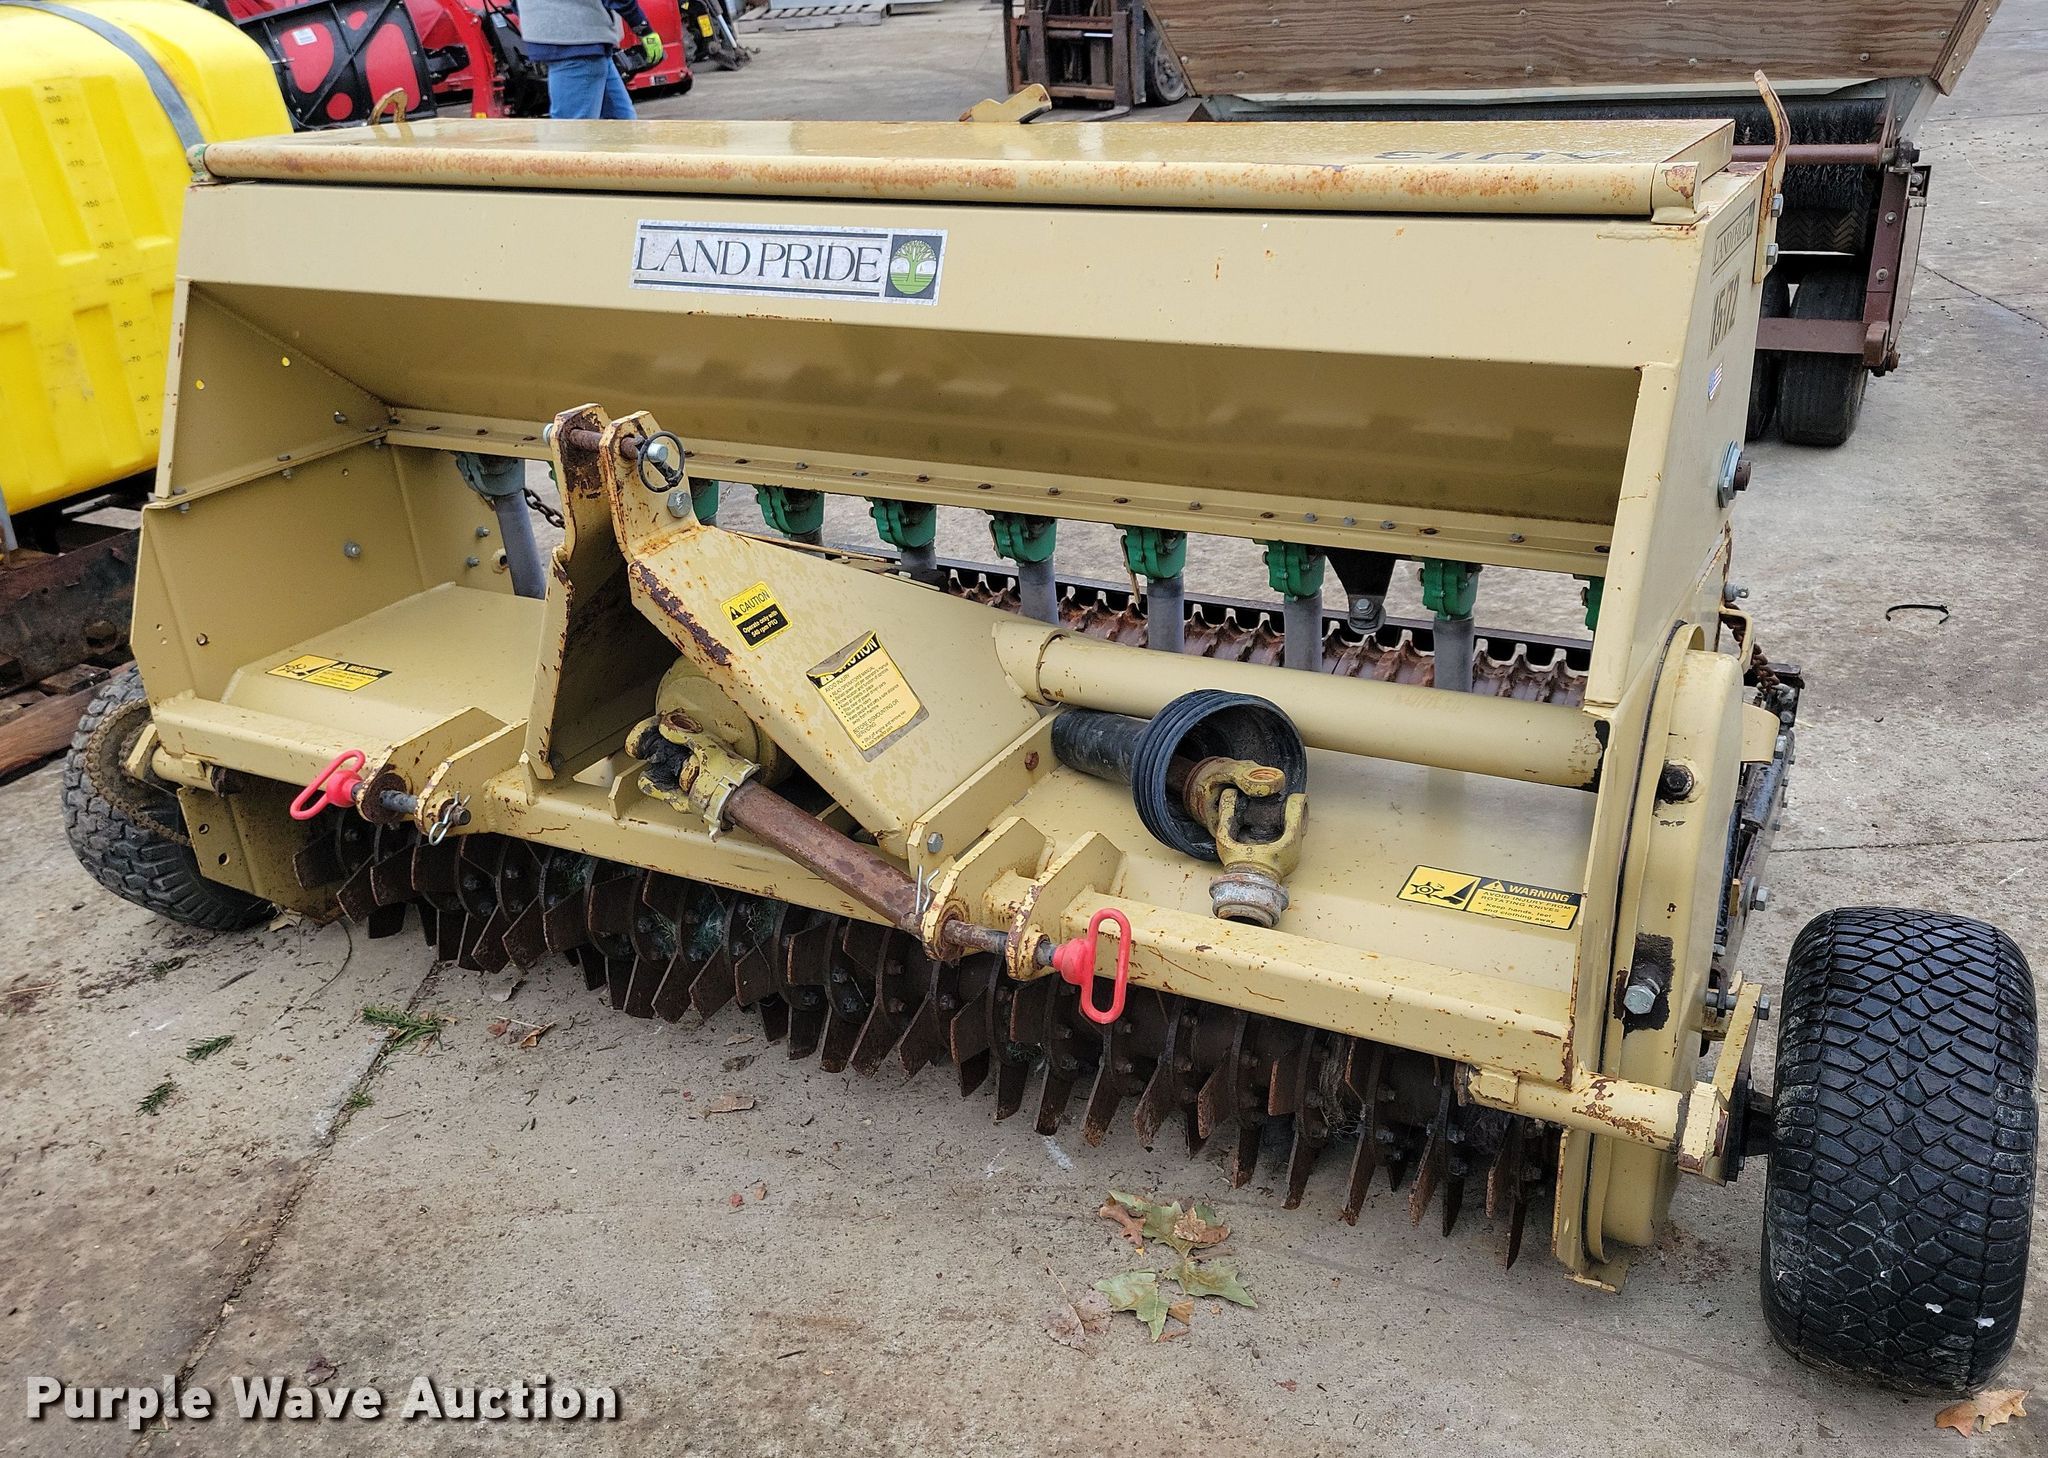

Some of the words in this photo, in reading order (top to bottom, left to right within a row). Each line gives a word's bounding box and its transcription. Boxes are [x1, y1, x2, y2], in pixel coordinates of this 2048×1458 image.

[636, 237, 751, 276] LAND
[758, 242, 883, 283] PRIDE
[739, 590, 770, 612] CAUTION
[743, 621, 760, 633] Operate
[768, 619, 778, 627] PTO
[825, 682, 838, 693] AVOID
[836, 674, 850, 685] INJURY
[1483, 891, 1510, 899] AVOID
[1509, 885, 1570, 901] WARNING
[1482, 896, 1526, 907] ROTATING
[1500, 911, 1532, 920] clothing
[1508, 907, 1534, 915] hands,
